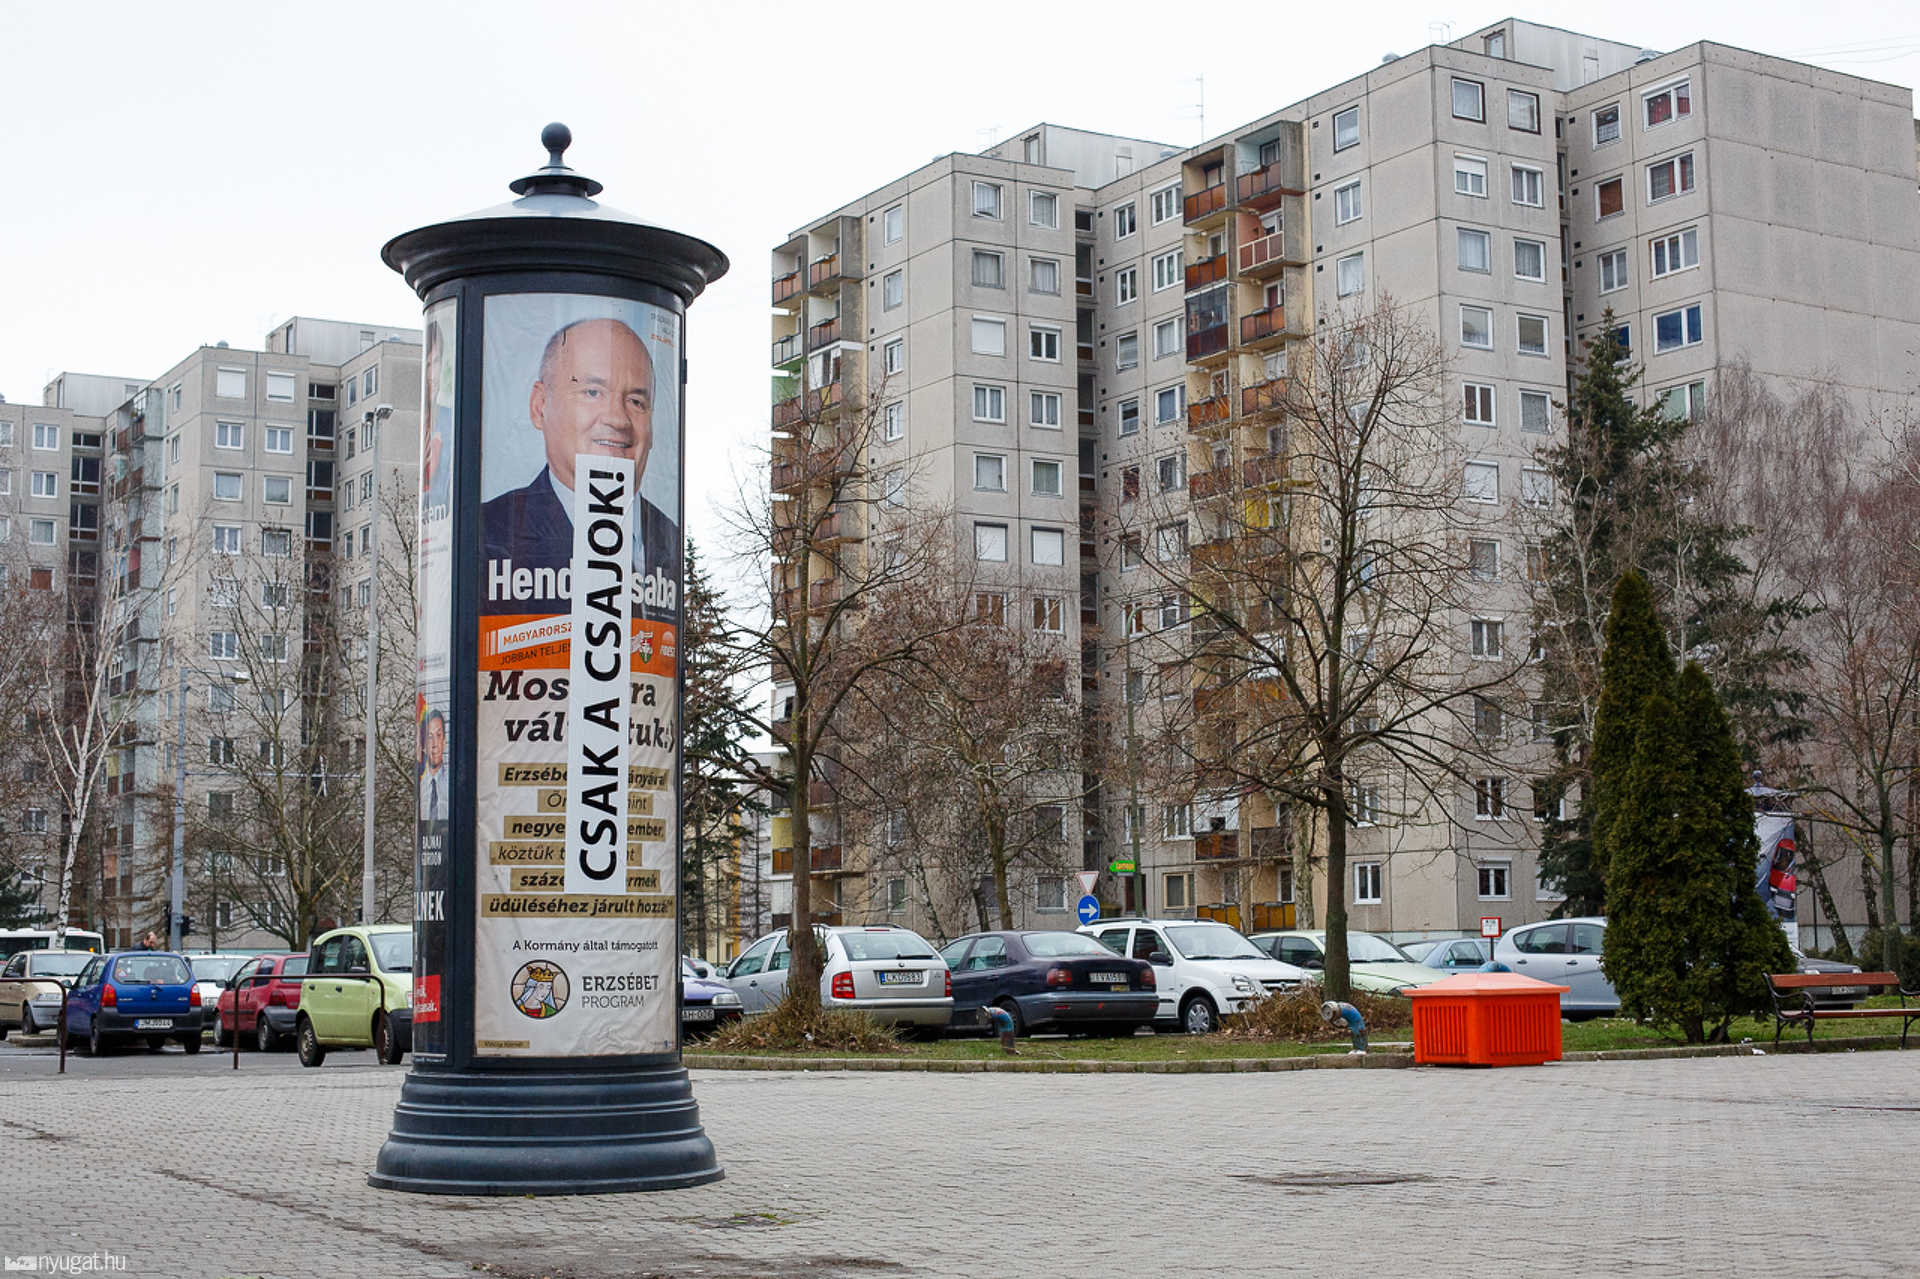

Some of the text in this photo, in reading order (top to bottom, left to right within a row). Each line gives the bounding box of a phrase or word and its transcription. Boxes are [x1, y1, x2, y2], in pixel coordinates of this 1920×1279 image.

[488, 558, 677, 612] Hend saba
[503, 621, 573, 647] MAGYARORSZ
[500, 641, 571, 666] JOBBAN TELJE
[579, 469, 625, 880] CSAK A CSAJOK!
[483, 670, 657, 708] Mos ra
[503, 711, 569, 743] vál
[511, 821, 566, 838] negye
[498, 842, 553, 861] köztük
[627, 873, 658, 888] rmek
[489, 897, 588, 914] üdüléséhez
[590, 898, 636, 917] járult
[512, 939, 659, 953] A Kormány által támogatott
[581, 971, 660, 992] ERZSÉBET
[581, 994, 645, 1009] PROGRAM
